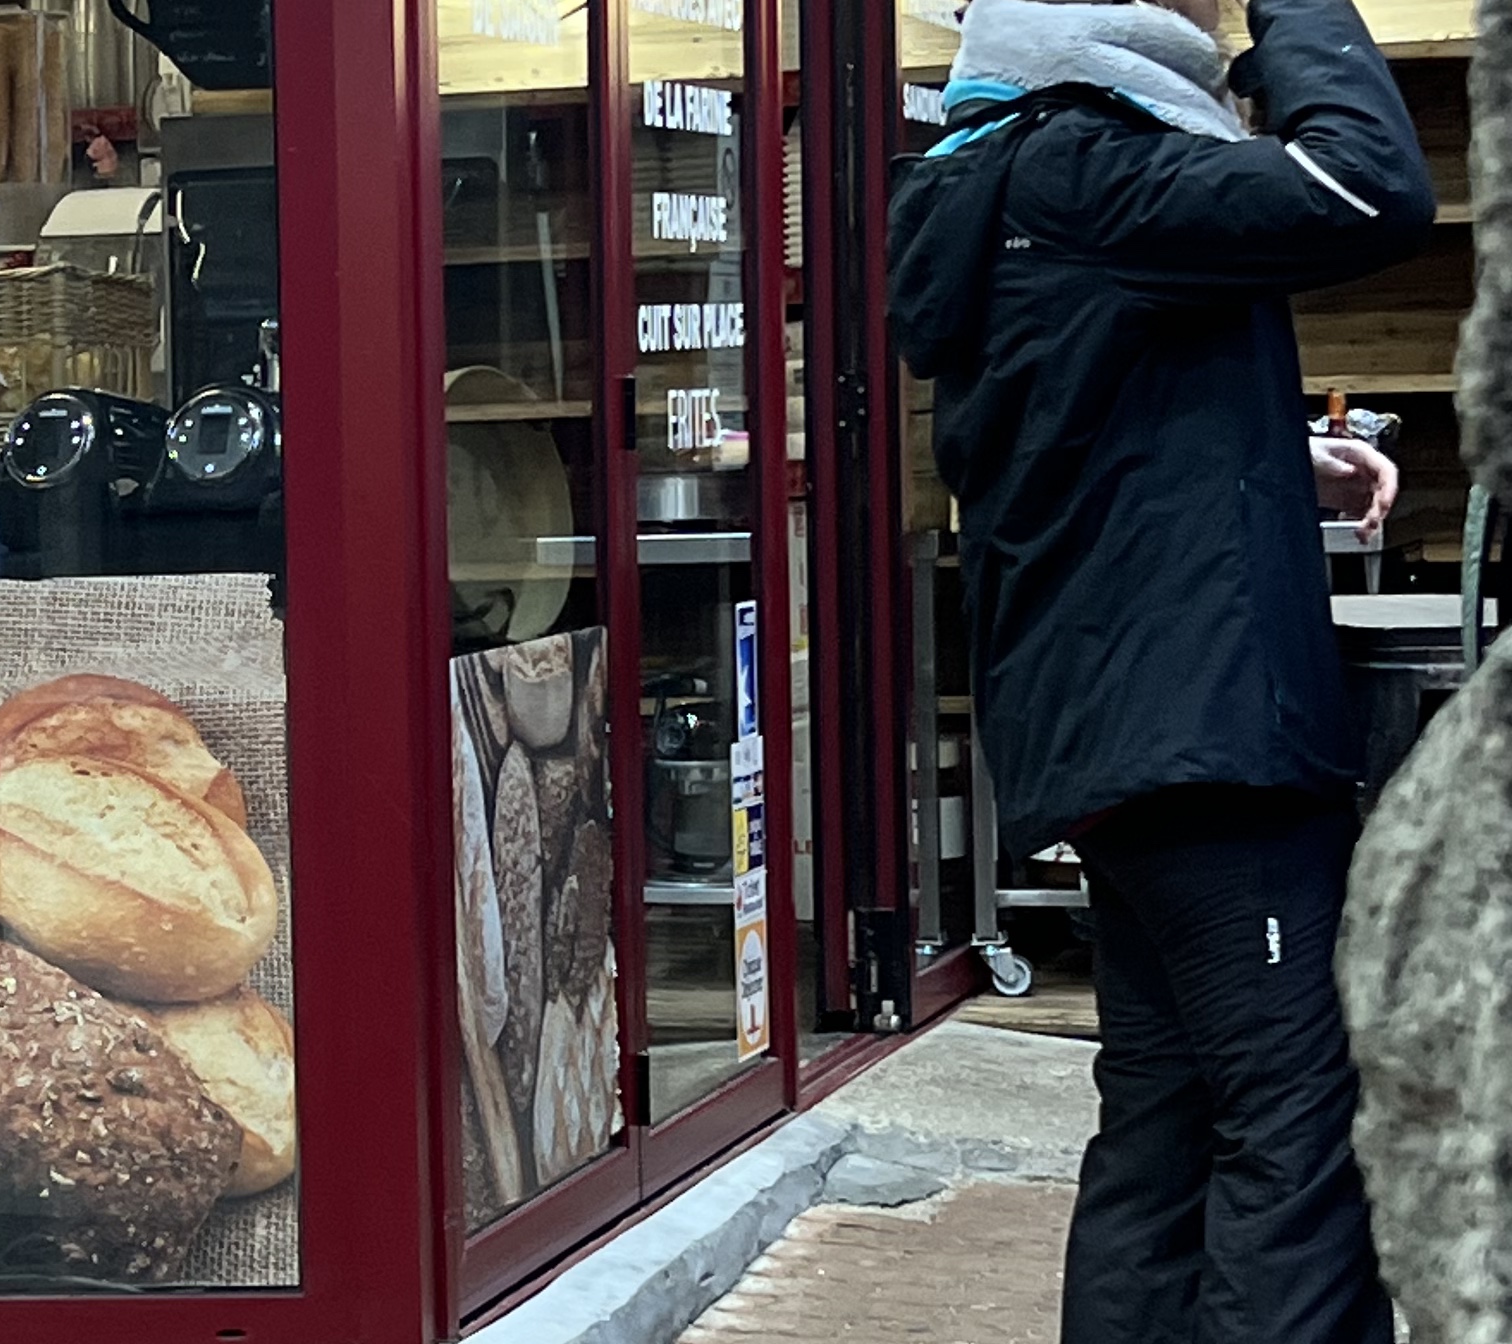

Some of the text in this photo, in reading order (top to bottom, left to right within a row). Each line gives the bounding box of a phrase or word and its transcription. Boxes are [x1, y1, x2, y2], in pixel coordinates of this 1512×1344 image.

[643, 79, 732, 136] DE LA FARINE
[652, 192, 728, 253] FRANÇAISE
[638, 302, 745, 353] CUIT SUR PLACE
[667, 388, 722, 449] FRITES
